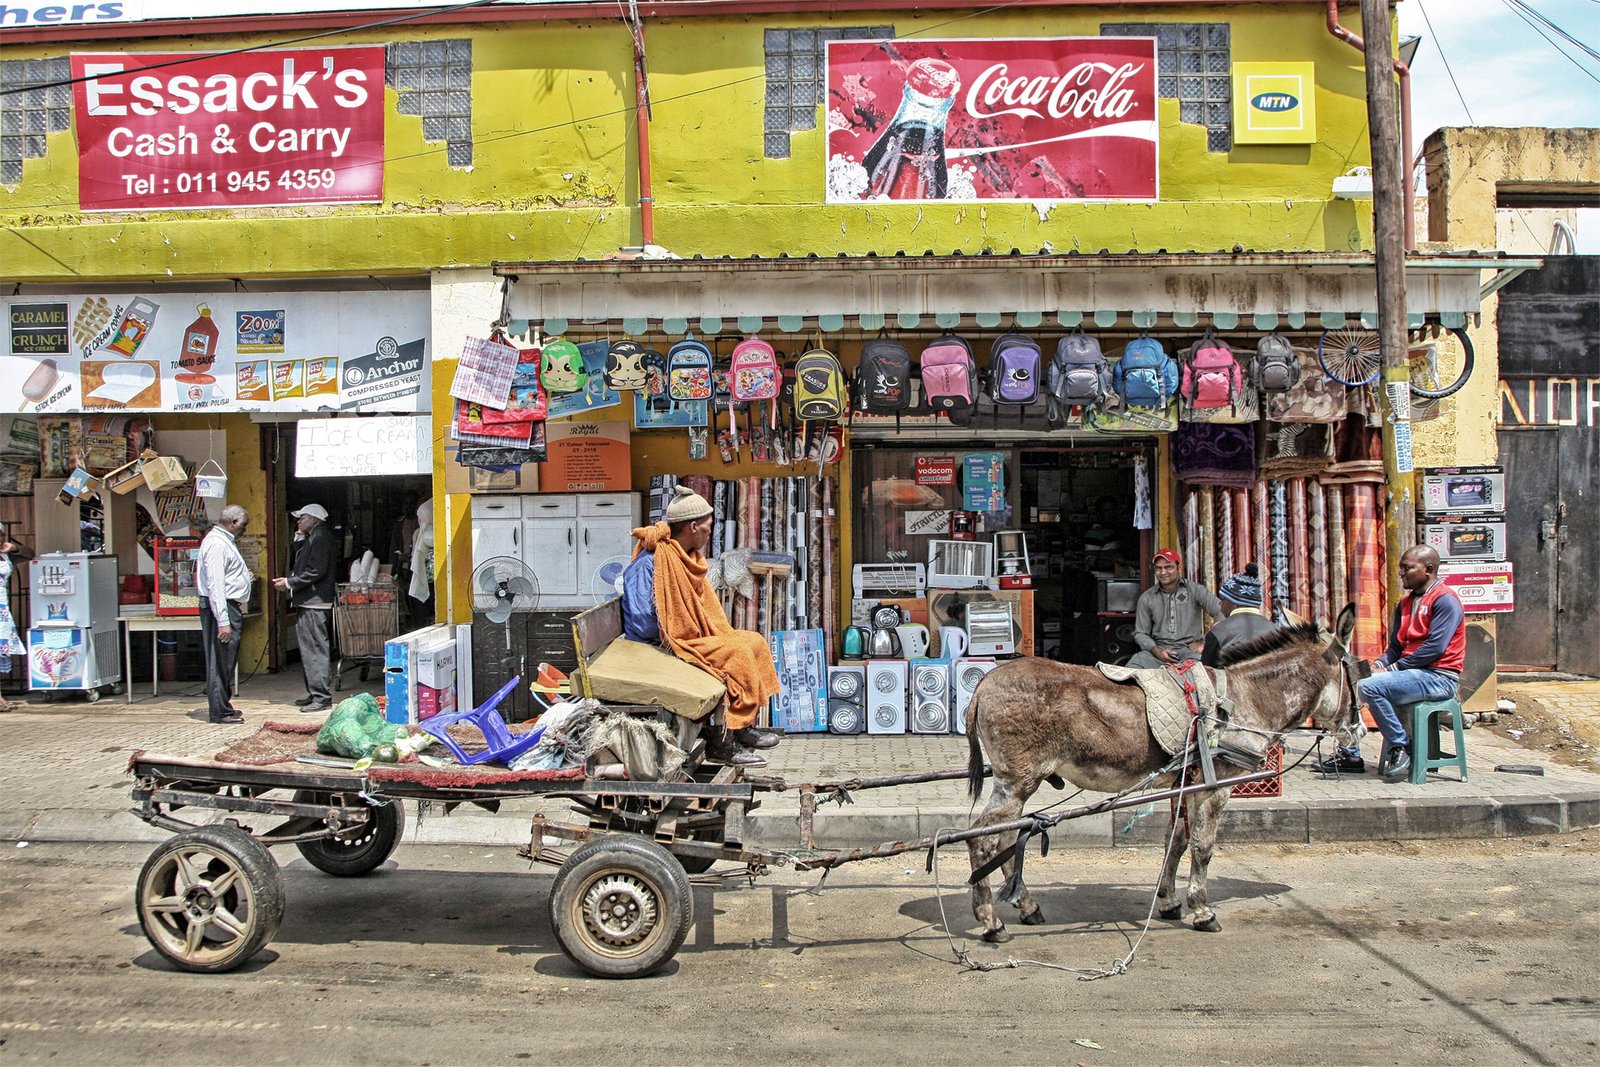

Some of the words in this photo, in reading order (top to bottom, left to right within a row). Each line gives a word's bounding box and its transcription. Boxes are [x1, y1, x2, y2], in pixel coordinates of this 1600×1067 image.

[84, 56, 369, 116] Essack's
[965, 61, 1146, 120] Coca-Cola
[1259, 96, 1290, 108] MTN
[107, 125, 198, 157] Cash
[211, 124, 238, 154] &
[249, 122, 352, 158] Carry
[121, 174, 155, 195] Tel
[176, 172, 217, 193] 011
[227, 170, 270, 192] 945
[277, 168, 336, 190] 4359
[11, 311, 67, 324] CARAMEL
[239, 314, 279, 333] ZOOM
[12, 334, 67, 346] CRUNCH
[82, 348, 93, 359] ICE
[170, 359, 195, 370] TOMATO
[196, 354, 216, 366] SAUCE
[365, 358, 419, 380] Anchor
[347, 379, 400, 397] COMPRESSED
[399, 374, 422, 386] YEAST
[570, 426, 600, 436] Royal
[1395, 423, 1406, 471] ABORTION
[918, 467, 953, 475] vodacom
[910, 509, 946, 533] STRICTLY
[1461, 588, 1482, 596] DEFY
